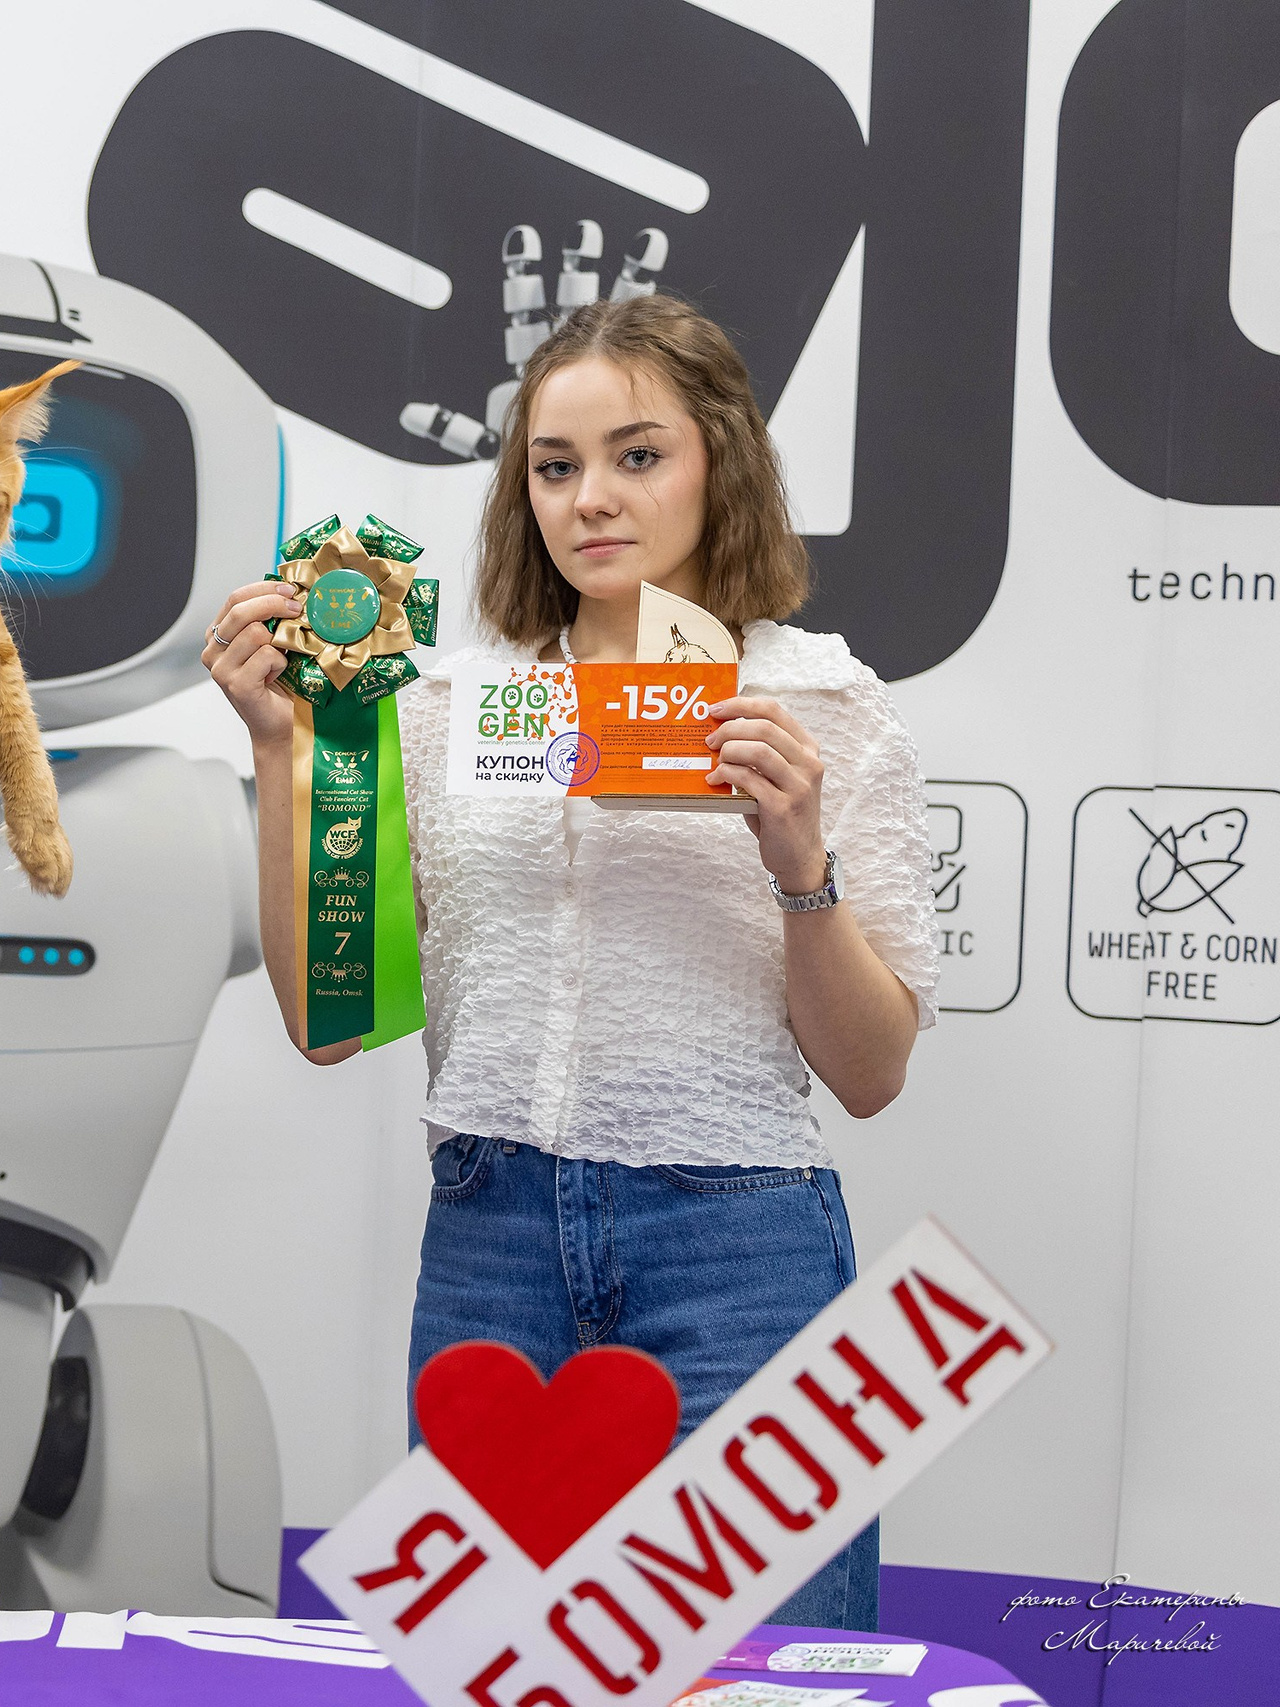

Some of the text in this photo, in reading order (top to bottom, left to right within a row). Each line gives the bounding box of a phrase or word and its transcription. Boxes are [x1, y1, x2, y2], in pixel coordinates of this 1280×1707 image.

[1127, 562, 1275, 602] techn
[480, 684, 548, 709] ZOO
[605, 685, 709, 722] -15%
[478, 712, 545, 737] GEN
[476, 755, 544, 769] КУПОН
[476, 772, 545, 783] на скидку
[330, 830, 356, 839] WCF
[325, 894, 357, 907] FUN
[318, 911, 365, 922] SHOW
[334, 931, 352, 955] 7
[1088, 931, 1277, 964] WHEAT & CORN
[316, 988, 341, 996] Russia,
[1147, 971, 1218, 1001] FREE
[350, 1510, 489, 1636] Я
